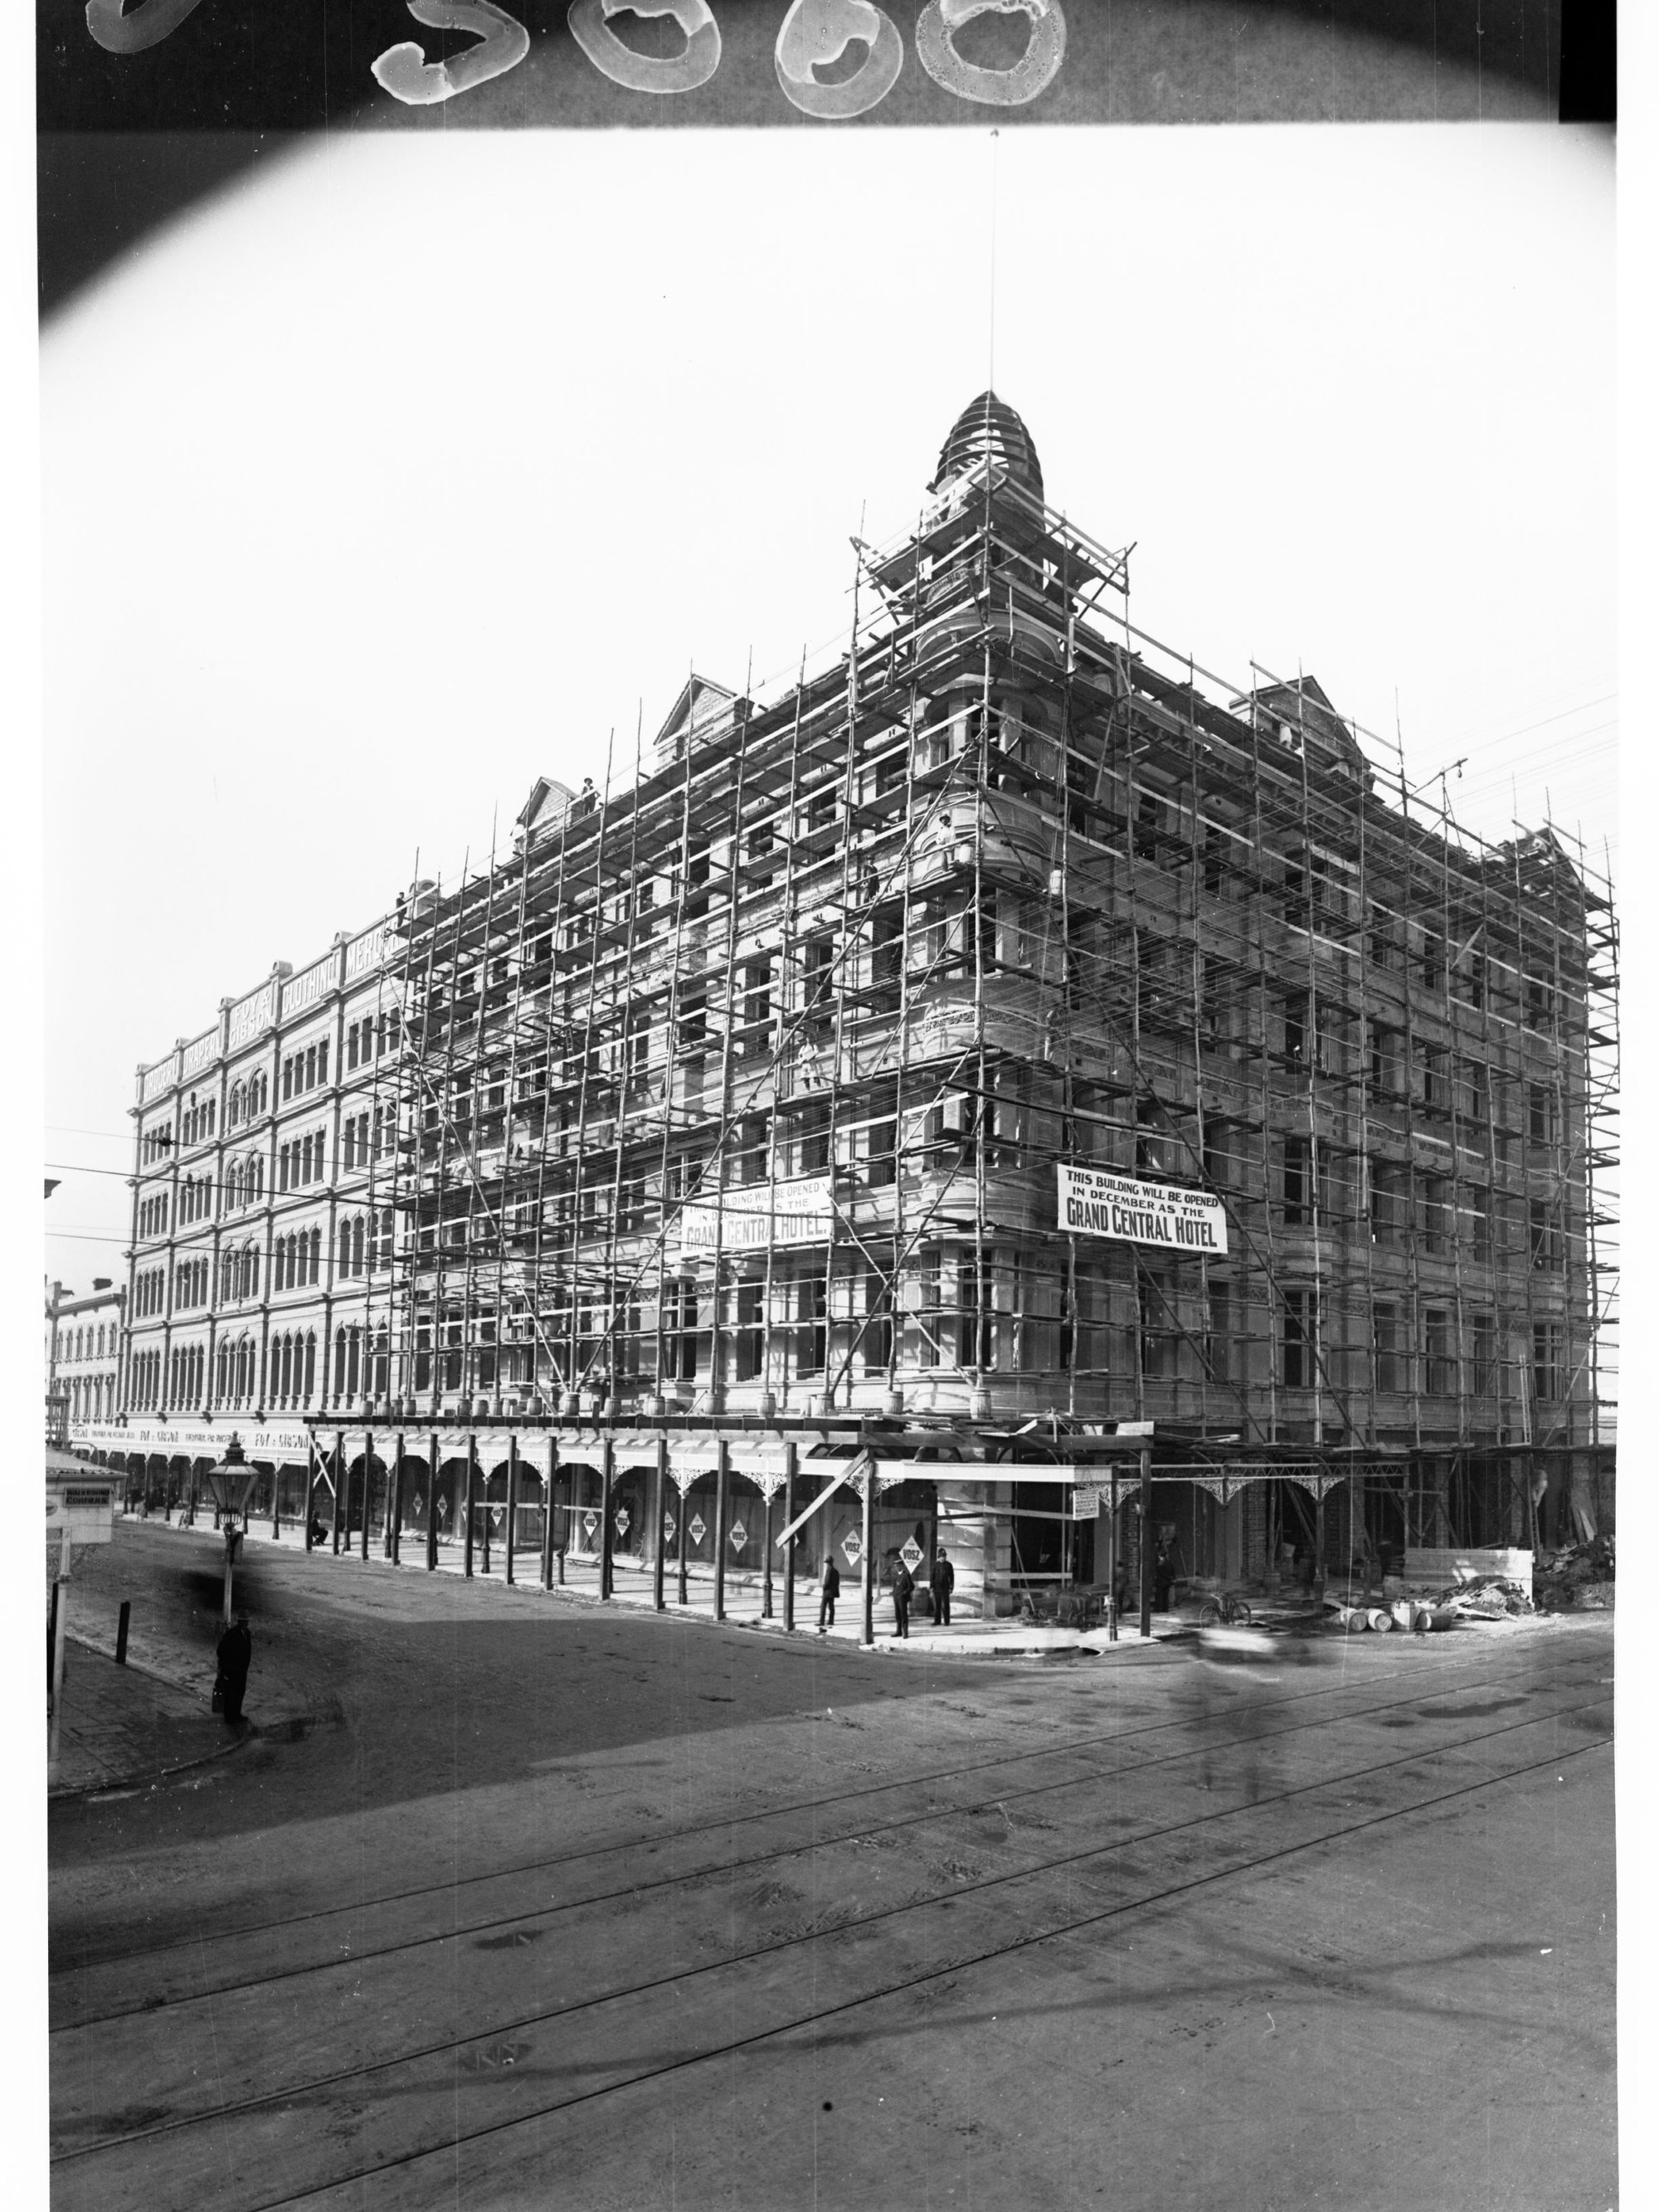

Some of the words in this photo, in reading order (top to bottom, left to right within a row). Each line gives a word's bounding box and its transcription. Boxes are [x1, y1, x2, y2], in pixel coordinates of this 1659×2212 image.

[236, 993, 260, 1026] FOY
[787, 1182, 820, 1196] OPENED
[1067, 1170, 1092, 1185] THIS
[1097, 1177, 1139, 1195] BUILDING
[1142, 1186, 1165, 1200] WILL
[1168, 1192, 1182, 1202] BE
[1185, 1194, 1219, 1207] OPENED
[1073, 1186, 1085, 1196] IN
[1090, 1190, 1155, 1210] DECEMBER
[1159, 1204, 1175, 1214] AS
[1181, 1207, 1205, 1218] THE
[788, 1198, 810, 1209] THE
[1067, 1197, 1108, 1231] GRAND
[1112, 1205, 1172, 1242] CENTRAL
[1175, 1216, 1217, 1247] HOTEL
[687, 1223, 720, 1251] GRAN
[844, 1542, 860, 1553] VOSZ
[903, 1549, 920, 1561] VOSZ
